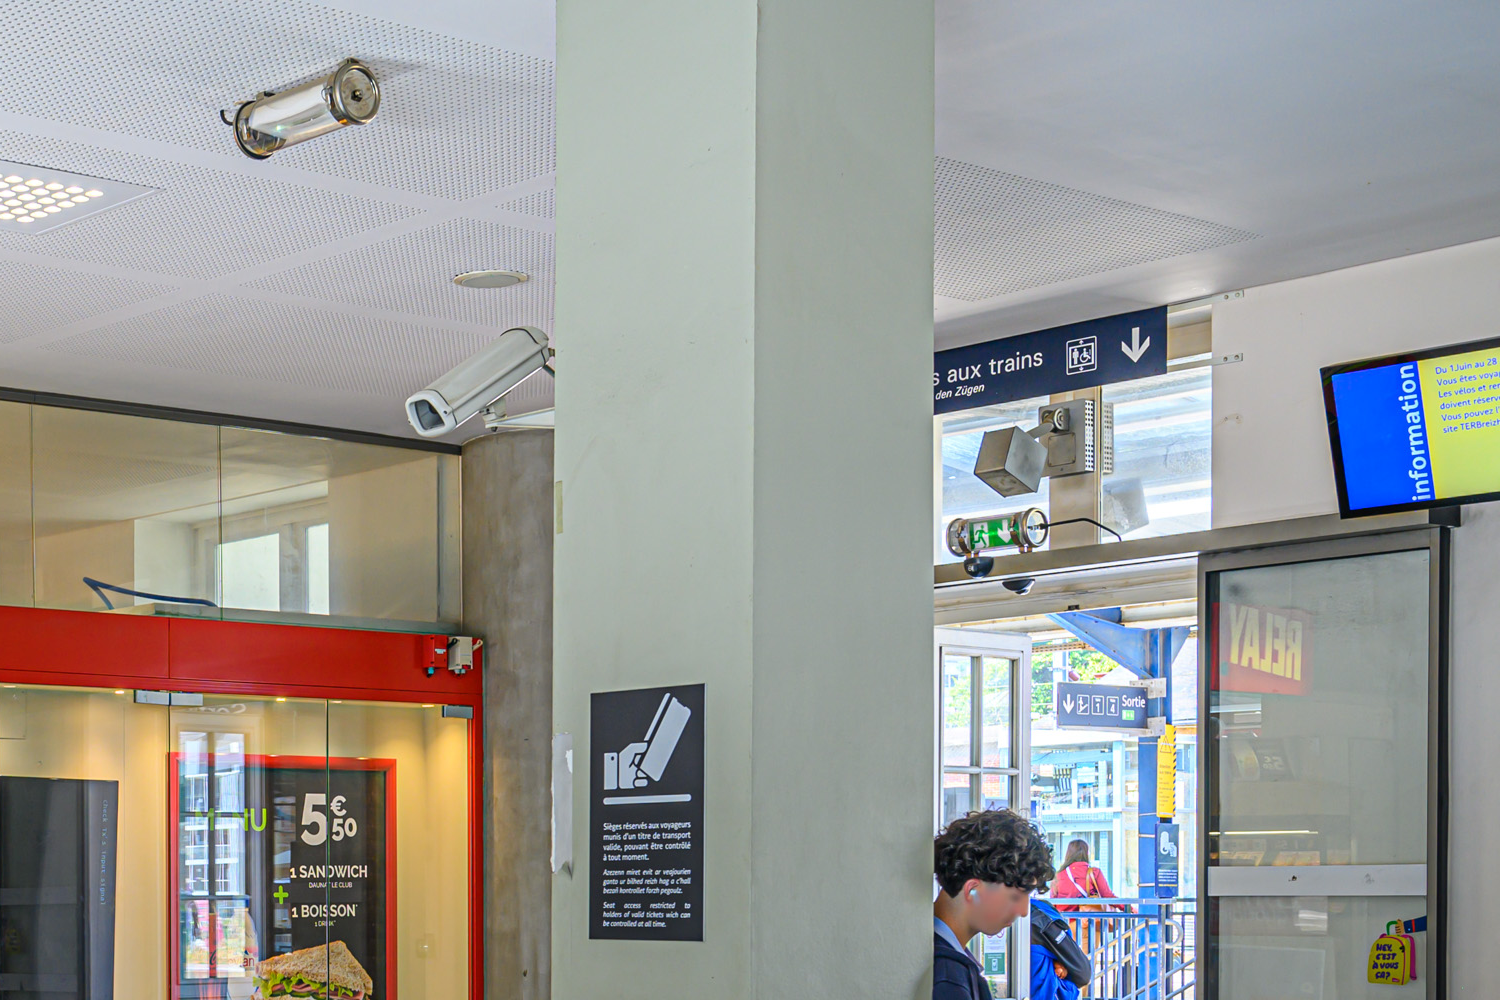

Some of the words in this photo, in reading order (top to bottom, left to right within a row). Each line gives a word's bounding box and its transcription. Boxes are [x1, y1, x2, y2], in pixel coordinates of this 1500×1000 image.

[947, 364, 981, 383] aux
[989, 352, 1043, 375] trains
[1435, 366, 1447, 374] Du
[1487, 357, 1497, 366] 28
[1436, 378, 1457, 386] Vous
[1459, 375, 1477, 383] êtes
[1479, 371, 1500, 380] voya
[935, 389, 952, 400] den
[955, 384, 985, 396] Zügen
[1438, 390, 1452, 398] Les
[1454, 387, 1476, 395] vélos
[1478, 384, 1487, 392] et
[1440, 399, 1471, 410] doivent
[1441, 413, 1462, 421] Vous
[1464, 408, 1494, 420] pouvez
[1398, 364, 1431, 501] information
[1443, 425, 1458, 433] site
[1122, 695, 1146, 708] Sortie
[301, 793, 327, 846] 5
[332, 817, 357, 841] 50
[603, 822, 622, 832] Sièges
[623, 821, 647, 830] réservés
[660, 821, 691, 830] voyageurs
[603, 832, 621, 840] munis
[623, 832, 636, 840] d'un
[637, 832, 651, 840] titre
[652, 831, 660, 839] de
[662, 831, 691, 840] transport
[603, 842, 622, 851] valide,
[624, 843, 649, 852] pouvant
[650, 842, 663, 850] être
[665, 841, 691, 849] contrôlé
[603, 853, 607, 861] à
[290, 868, 297, 878] 1
[299, 864, 367, 878] SANDWICH
[291, 907, 298, 918] 1
[1376, 952, 1397, 960] C'EST
[1372, 960, 1379, 969] À
[1375, 971, 1391, 980] ÇA?
